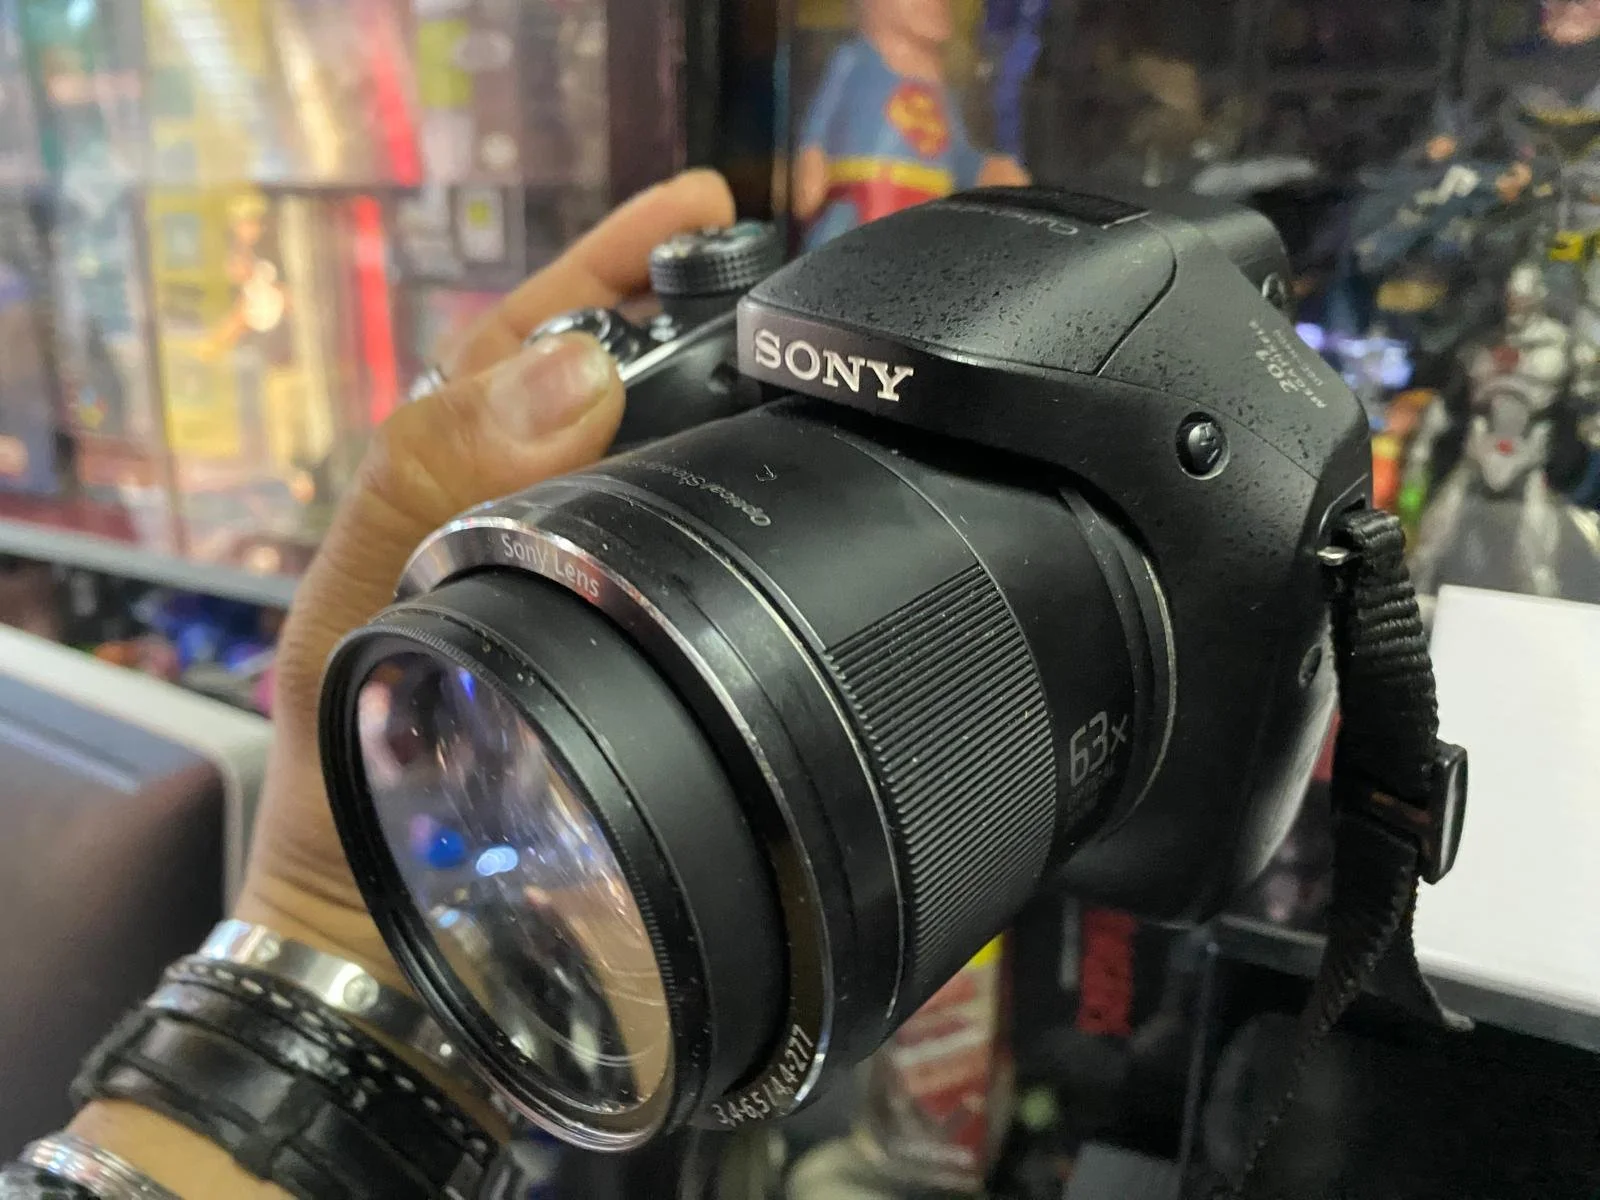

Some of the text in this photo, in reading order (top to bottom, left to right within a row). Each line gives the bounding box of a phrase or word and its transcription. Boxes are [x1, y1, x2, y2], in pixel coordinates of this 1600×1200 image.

[754, 328, 914, 402] SONY
[501, 532, 600, 598] Sony Lens
[1069, 710, 1128, 787] 63x
